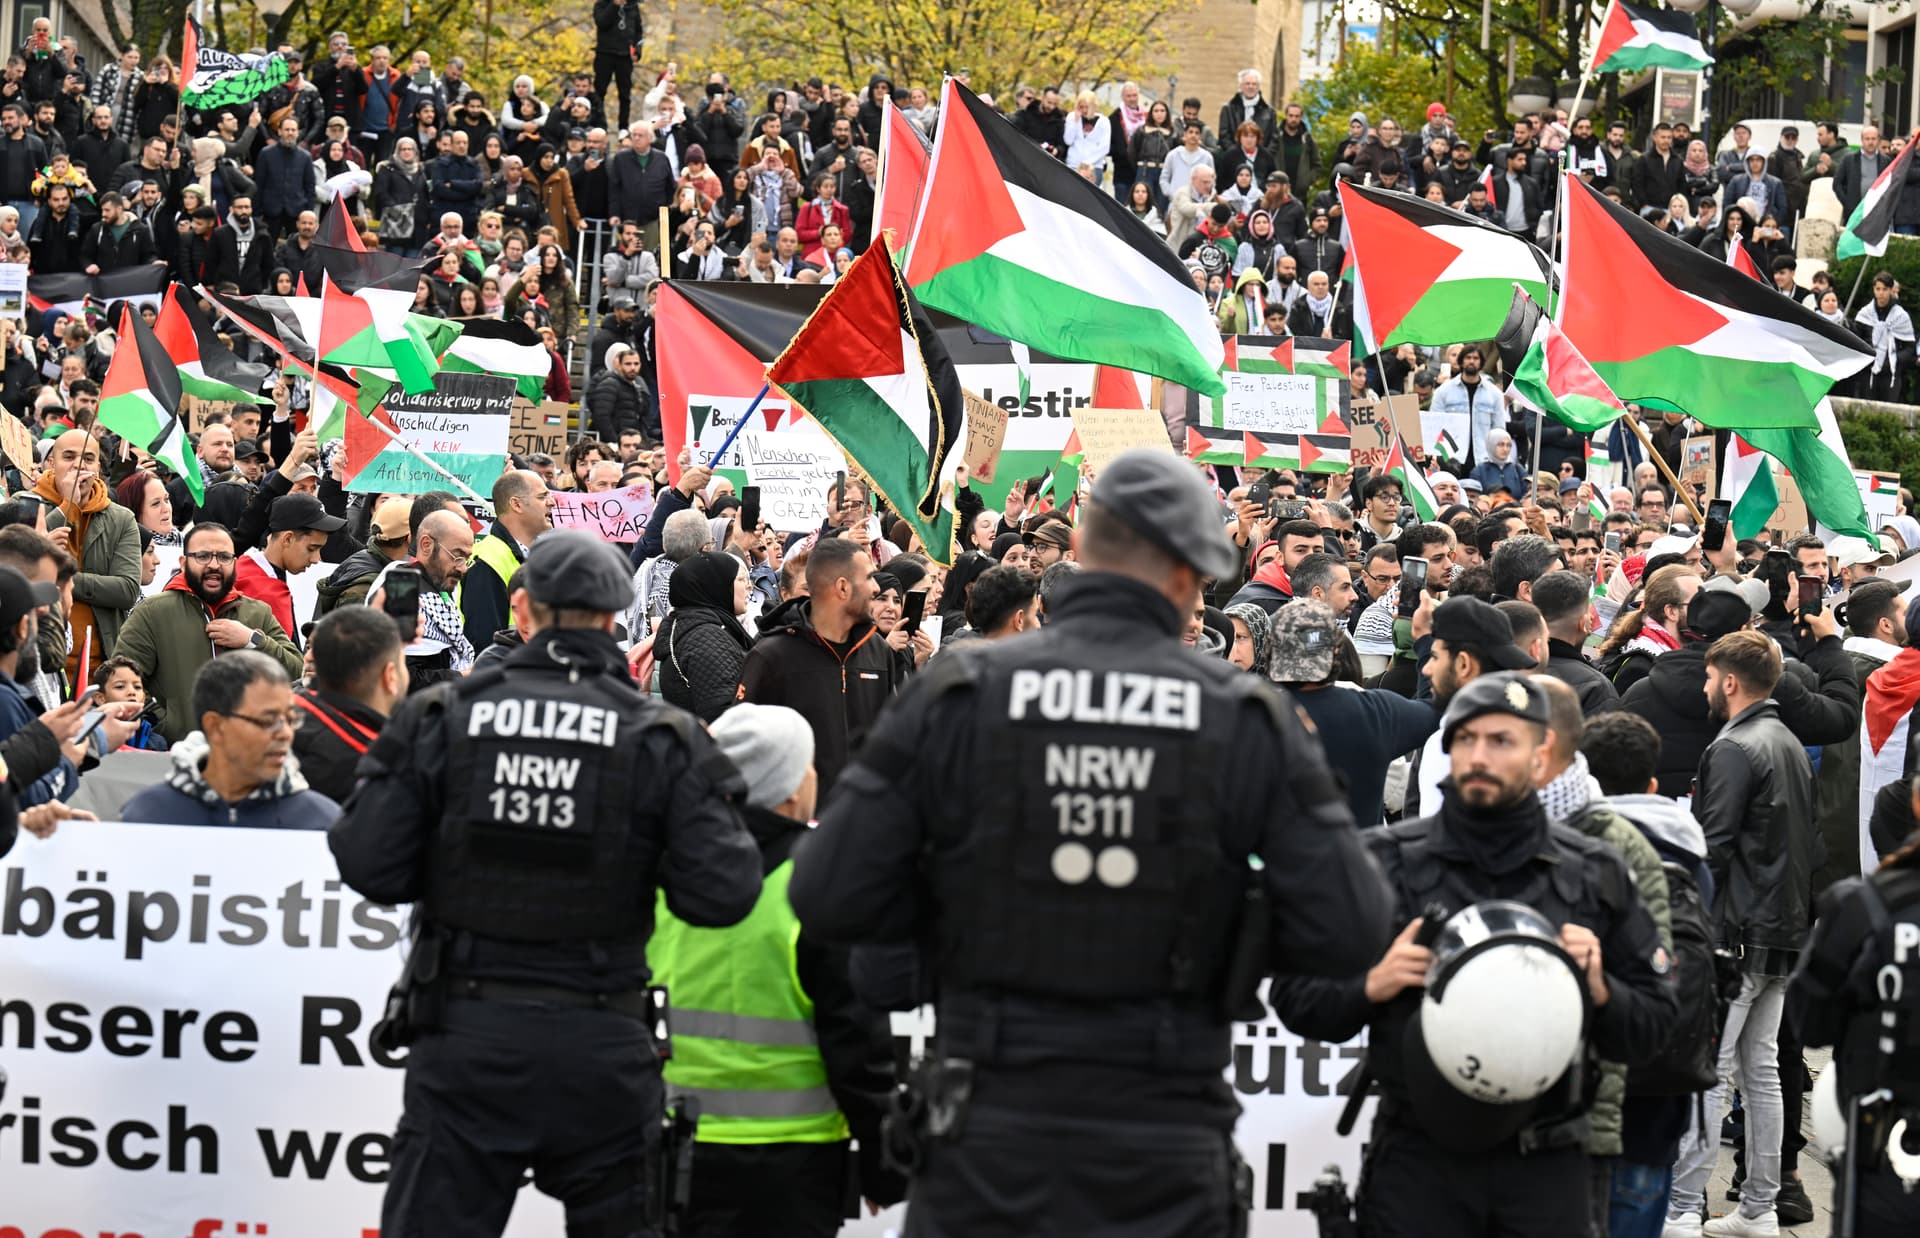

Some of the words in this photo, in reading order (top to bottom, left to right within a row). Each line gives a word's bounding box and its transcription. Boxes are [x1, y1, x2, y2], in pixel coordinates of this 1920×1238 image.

[1231, 376, 1255, 392] Free
[1260, 376, 1310, 392] Palestine
[486, 396, 513, 409] mit
[1231, 402, 1265, 418] Freies
[390, 411, 471, 434] Unschuldigen
[976, 420, 997, 435] HAVE
[432, 440, 462, 453] KEIN
[509, 434, 563, 456] STINE
[983, 434, 995, 448] TO
[755, 467, 800, 478] rechte
[760, 483, 794, 495] auch
[799, 486, 823, 498] im
[553, 499, 623, 526] #NO
[599, 513, 648, 538] WAR
[1008, 668, 1200, 731] POLIZEI
[467, 698, 619, 748] POLIZEI
[494, 751, 581, 791] NRW
[1045, 743, 1155, 791] NRW
[488, 787, 575, 828] 1313
[1051, 792, 1134, 839] 1311
